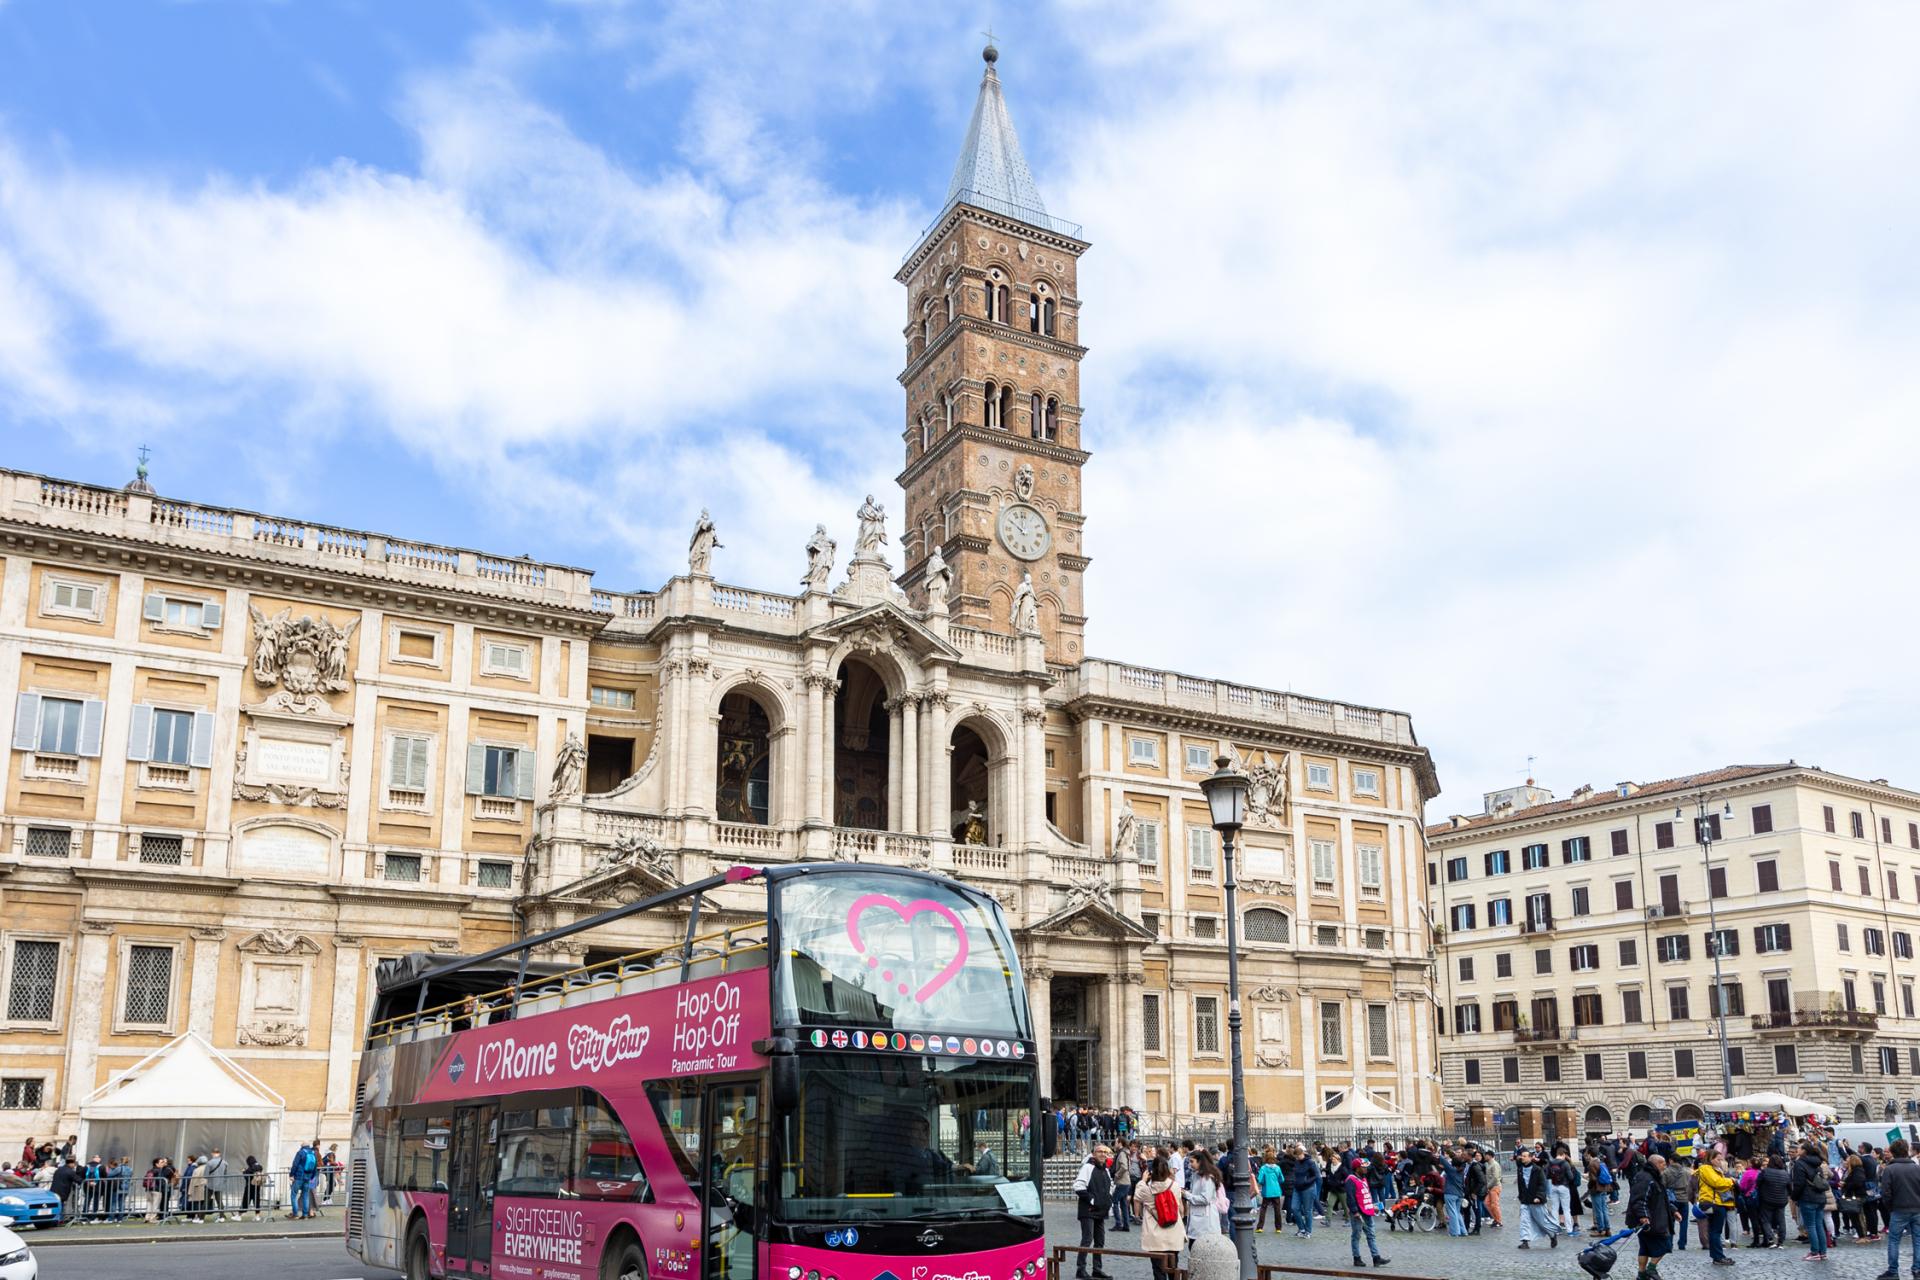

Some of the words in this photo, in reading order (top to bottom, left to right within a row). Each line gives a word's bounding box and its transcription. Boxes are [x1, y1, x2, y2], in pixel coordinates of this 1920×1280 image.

[711, 641, 763, 658] ENEDICTVS
[676, 981, 740, 1023] Hop-On
[673, 1013, 741, 1057] Hop-Off
[501, 1038, 558, 1081] Rome
[671, 1054, 715, 1074] Panoramic
[716, 1053, 738, 1069] Tour
[505, 1206, 583, 1238] SIGHTSEEING
[504, 1232, 582, 1265] EVERYWHERE
